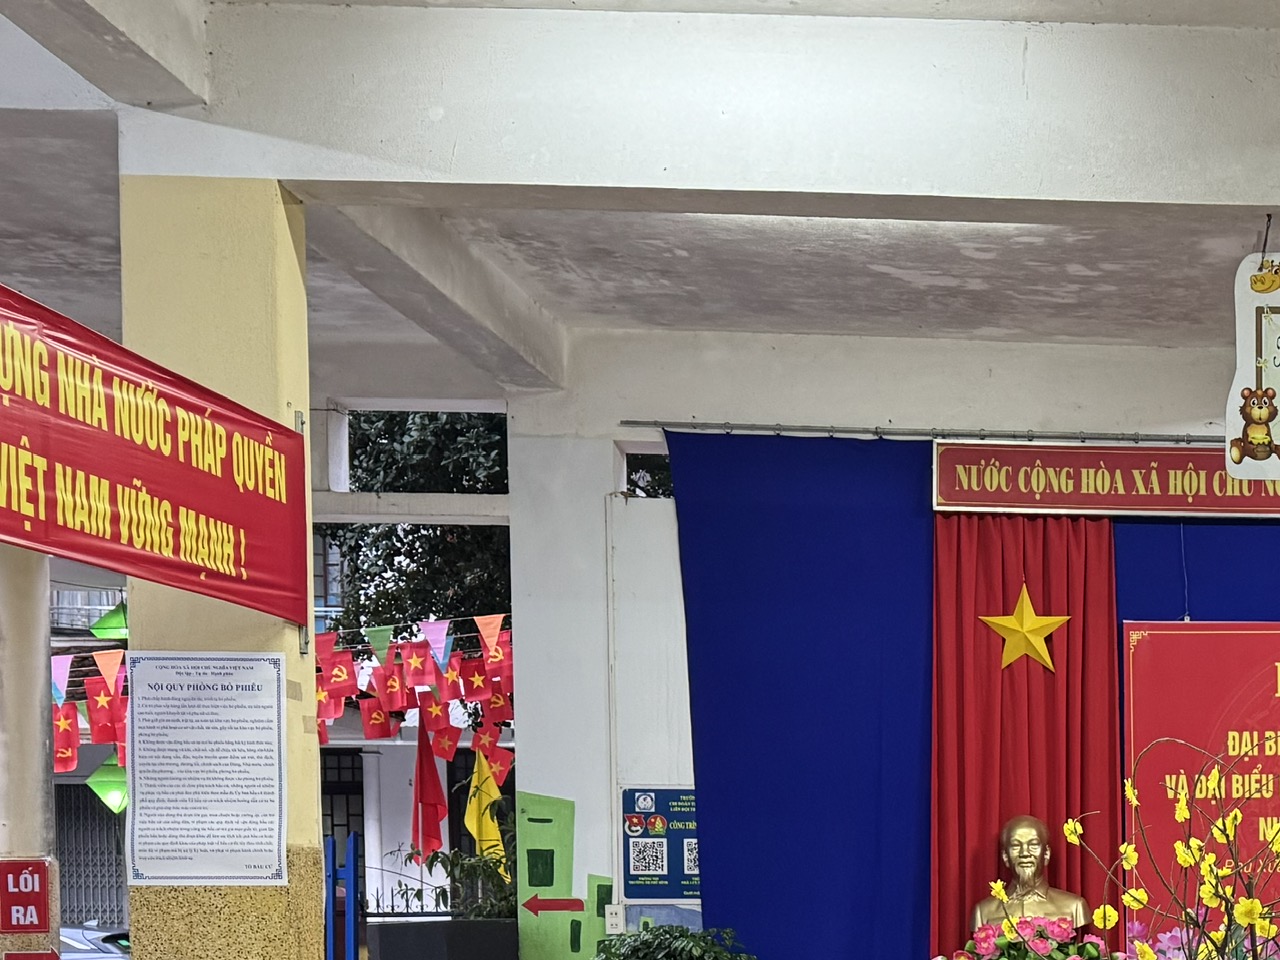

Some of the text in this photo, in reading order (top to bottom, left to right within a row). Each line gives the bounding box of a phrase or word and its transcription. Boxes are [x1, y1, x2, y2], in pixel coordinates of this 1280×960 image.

[57, 353, 108, 431] NHÀ
[113, 376, 172, 457] NƯỚC
[176, 407, 227, 477] PHÁP
[232, 431, 287, 504] QUYỀN
[955, 457, 1012, 492] NƯỚC
[1018, 459, 1075, 501] CỘNG
[1080, 460, 1126, 495] HÒA
[1132, 461, 1161, 495] XÃ
[1167, 462, 1207, 503] HỘI
[55, 462, 111, 540] NAM
[116, 477, 174, 559] VỮNG
[178, 505, 236, 580] MẠNH
[239, 528, 247, 580] !
[147, 682, 164, 692] NỘI
[165, 682, 184, 692] QUY
[186, 681, 218, 691] PHÒNG
[1227, 731, 1259, 762] ĐẠI
[1165, 769, 1189, 799] VÀ
[1231, 764, 1274, 799] BIỂU
[7, 866, 40, 893] LỐI
[11, 905, 39, 925] RA
